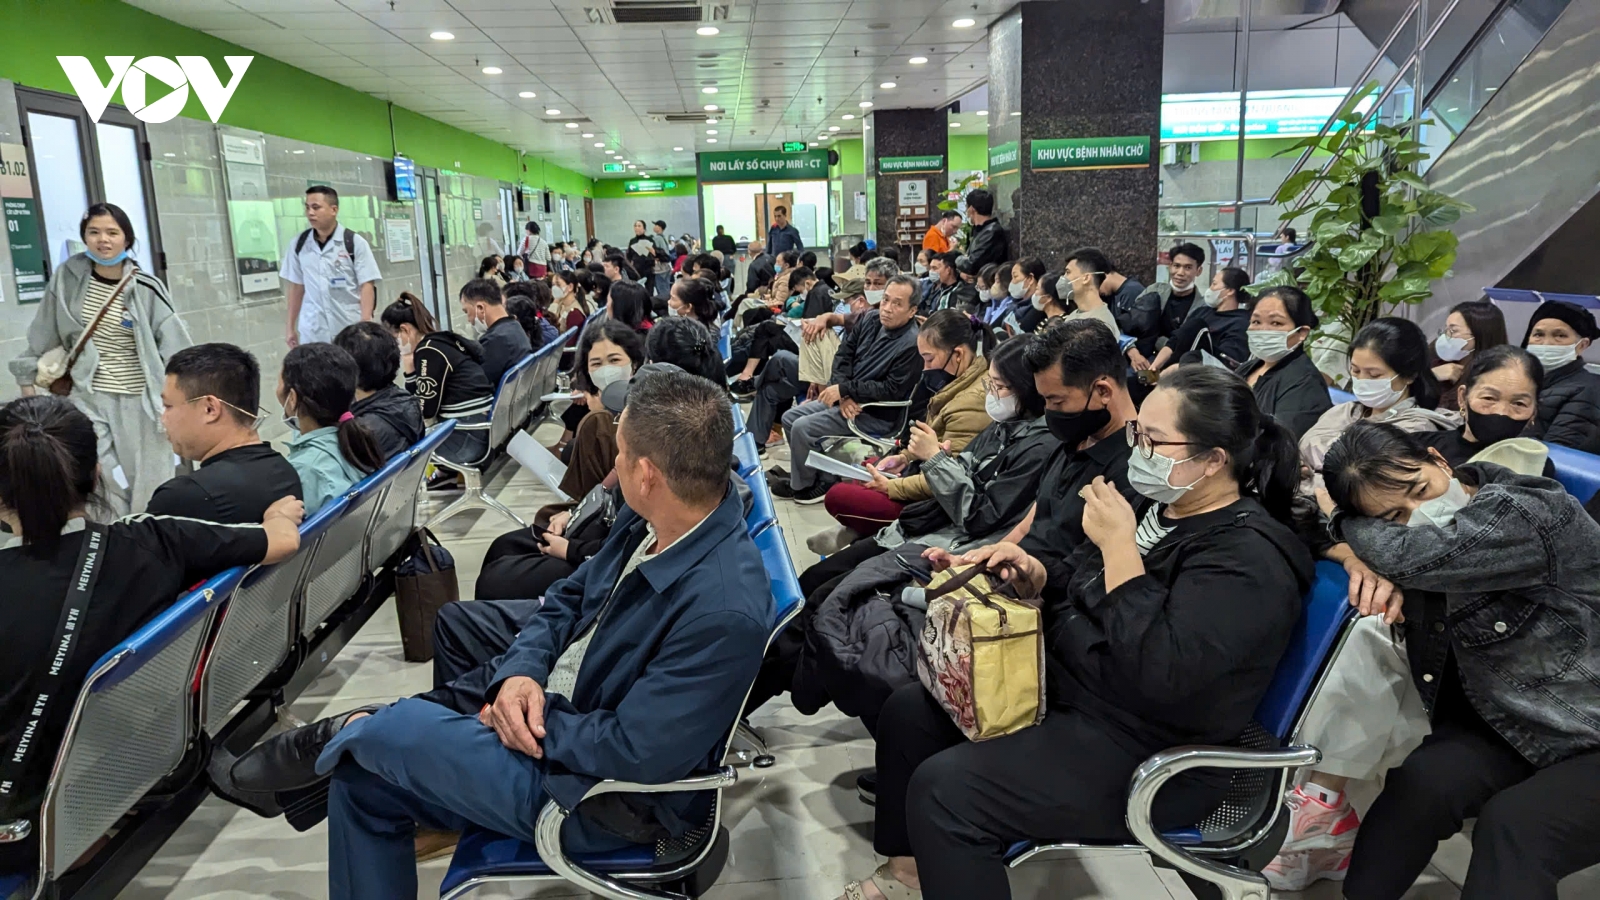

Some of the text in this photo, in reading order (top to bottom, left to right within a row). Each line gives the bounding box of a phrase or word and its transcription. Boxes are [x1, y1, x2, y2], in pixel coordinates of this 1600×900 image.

[1038, 143, 1144, 162] KHU VỰC BỆNH NHÂN CHỜ
[710, 161, 727, 171] NƠI
[728, 159, 745, 171] LẤY
[746, 158, 759, 170] SỐ
[760, 160, 785, 172] CHỤP
[786, 159, 803, 169] MRI
[809, 158, 821, 168] CT
[903, 160, 916, 169] BỆNH
[8, 220, 19, 232] 01
[77, 552, 97, 591] MEIYINA
[48, 633, 72, 676] MEIYINA
[12, 693, 49, 763] MEIYINA MYN
